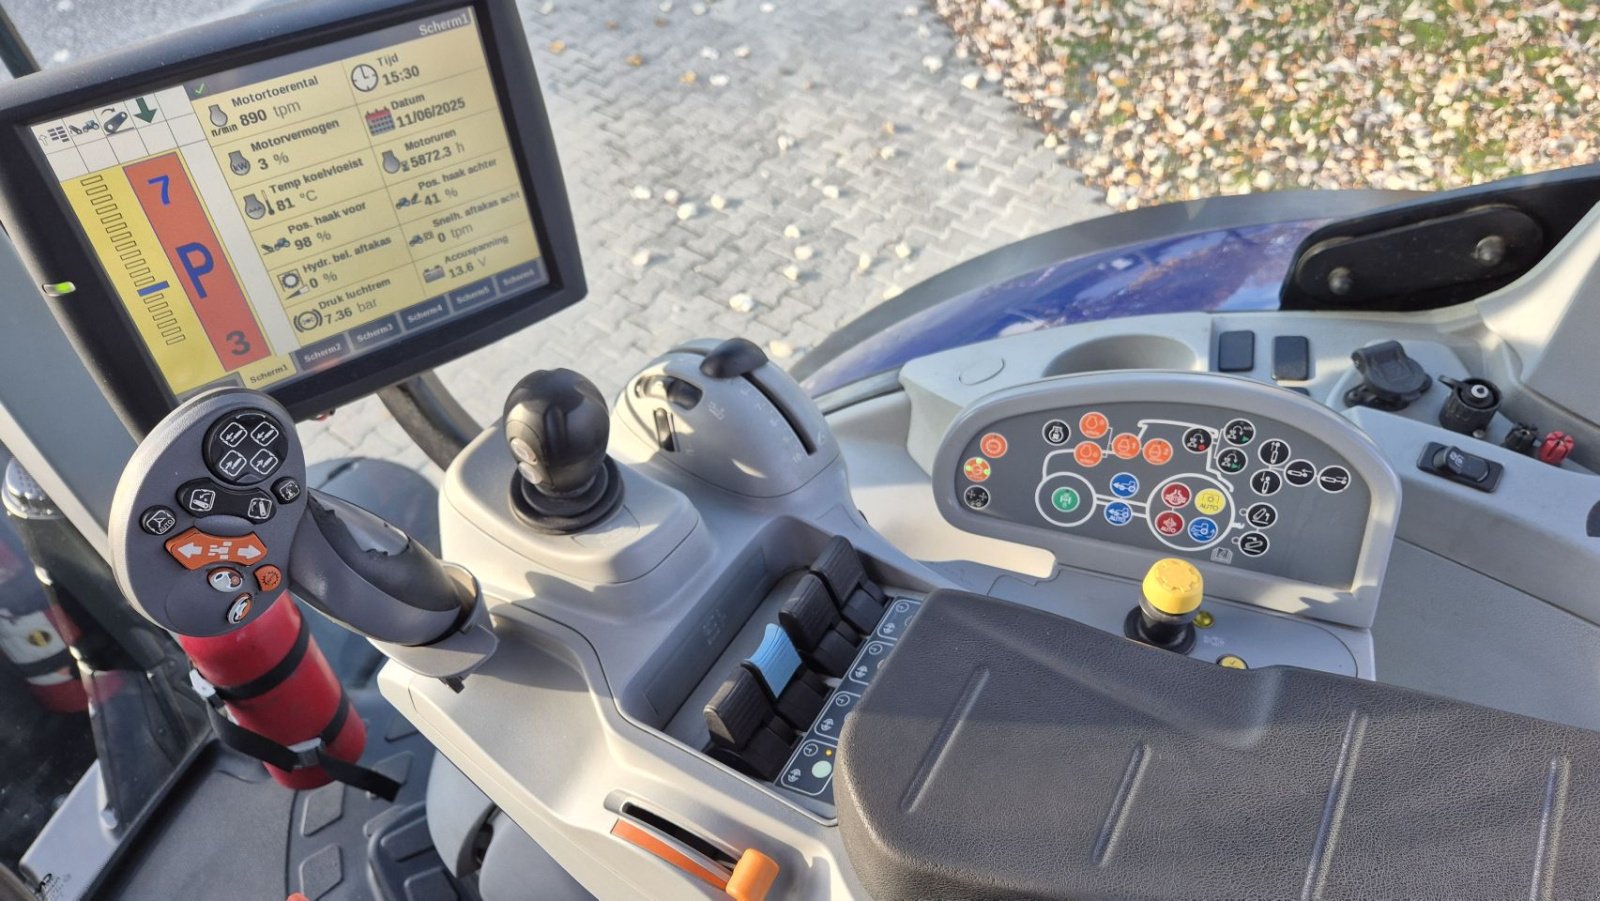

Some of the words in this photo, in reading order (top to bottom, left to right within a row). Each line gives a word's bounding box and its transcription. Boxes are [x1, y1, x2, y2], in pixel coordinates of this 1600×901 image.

[418, 13, 470, 36] Scherm1
[376, 53, 399, 68] Tijd
[382, 65, 420, 86] 15:30
[231, 75, 319, 108] Motortoerental
[390, 94, 425, 111] Datum
[239, 109, 268, 127] 890
[273, 101, 302, 119] tpm
[396, 97, 466, 128] 11/06/2025
[211, 123, 238, 138] n/min
[250, 119, 340, 152] Motorvermogen
[404, 128, 457, 152] Motoruren
[257, 158, 269, 170] 3
[273, 152, 290, 166] %
[409, 146, 452, 168] 5872.3
[455, 142, 465, 154] h
[269, 179, 301, 195] Temp
[302, 158, 364, 184] koelvloeist
[418, 179, 441, 190] Pos.
[442, 169, 466, 183] haak
[467, 158, 497, 174] achter
[148, 175, 170, 206] 7
[276, 197, 296, 212] 81
[299, 190, 318, 202] °C
[424, 193, 441, 206] 41
[444, 187, 458, 199] %
[287, 223, 313, 235] Pos.
[313, 211, 340, 225] haak
[341, 202, 367, 216] voor
[432, 212, 463, 228] Snelh.
[464, 199, 499, 217] aftakas
[500, 191, 521, 204] acht
[294, 236, 313, 250] 98
[316, 230, 332, 243] %
[437, 232, 447, 243] 0
[450, 223, 474, 239] tpm
[302, 258, 331, 274] Hydr.
[332, 249, 353, 263] bel.
[354, 236, 392, 256] aftakas
[444, 235, 509, 264] Accuspanning
[175, 242, 214, 299] P
[449, 262, 474, 278] 13.6
[477, 256, 488, 267] V
[309, 278, 319, 289] 0
[323, 271, 338, 283] %
[318, 295, 345, 310] Druk
[345, 279, 391, 300] luchtrem
[324, 307, 353, 324] 7.36
[356, 298, 377, 312] bar
[226, 331, 250, 355] 3
[249, 364, 289, 384] Scherm1
[303, 343, 342, 363] Scherm2
[356, 323, 394, 342] Scherm3
[407, 304, 443, 323] Scherm4
[1108, 514, 1127, 523] AUTO
[1199, 503, 1219, 511] AUTO
[159, 519, 174, 533] AUTO
[1160, 525, 1176, 534] AUTO
